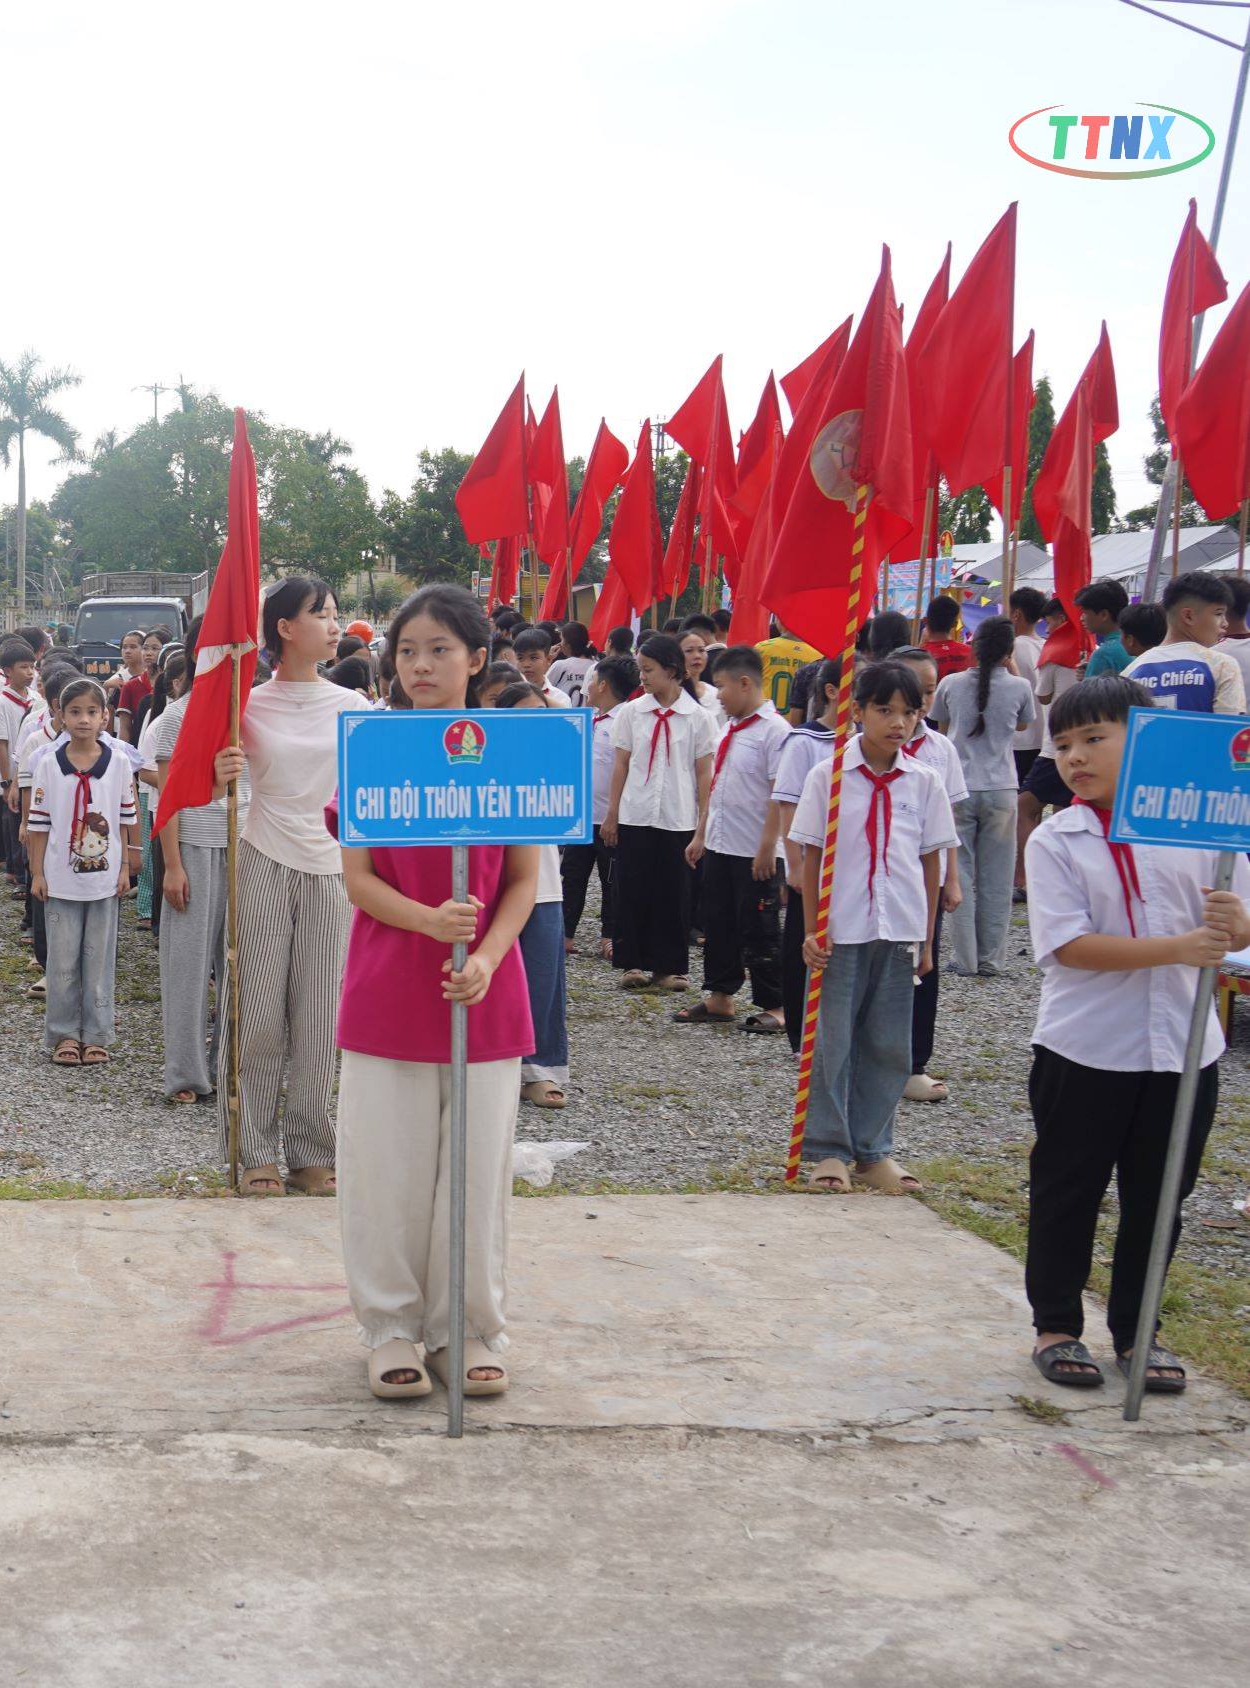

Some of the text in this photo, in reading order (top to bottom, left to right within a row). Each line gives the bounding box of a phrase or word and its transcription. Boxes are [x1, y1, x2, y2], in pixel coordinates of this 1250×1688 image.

[1160, 667, 1205, 687] Chiến
[355, 777, 575, 827] CHI ĐỘI THÔN YÊN THÀNH
[1132, 784, 1166, 819] CHI
[1166, 781, 1201, 829] ĐỘI
